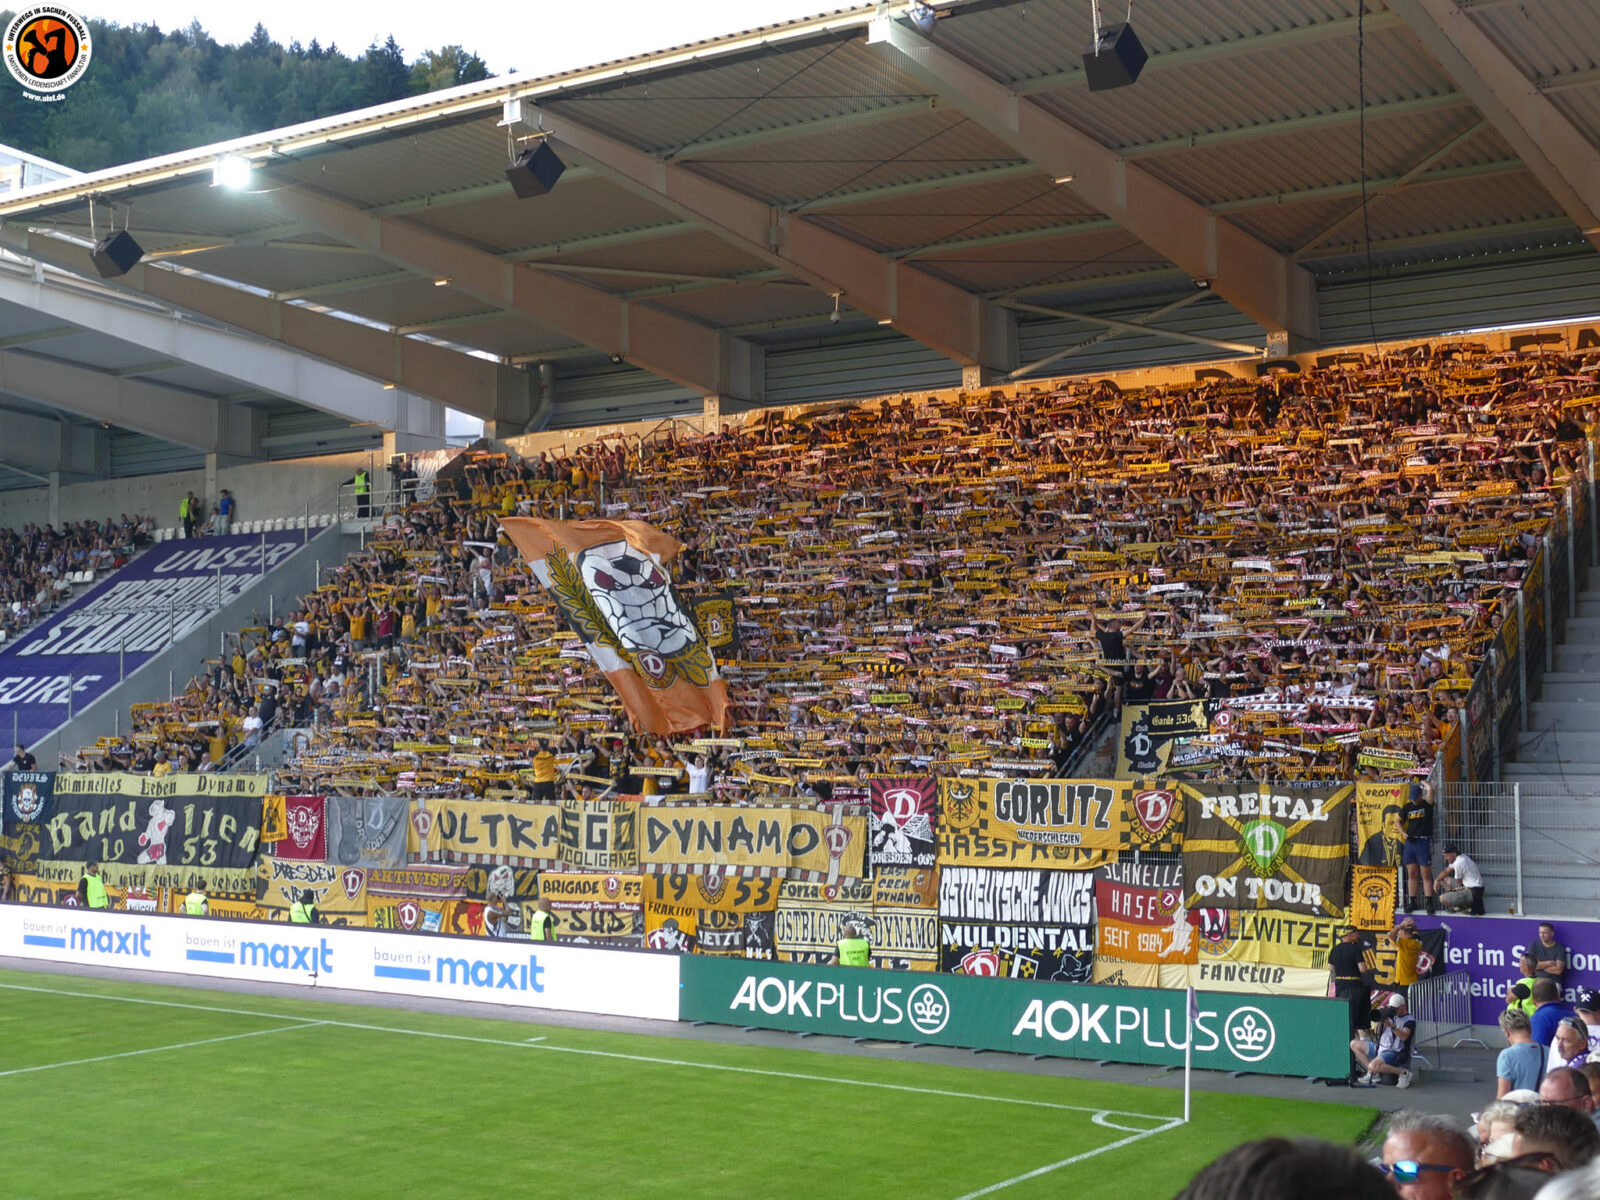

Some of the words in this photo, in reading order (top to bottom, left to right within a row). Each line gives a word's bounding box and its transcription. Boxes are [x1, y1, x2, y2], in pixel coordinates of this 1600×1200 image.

[153, 542, 297, 573] UNSER
[196, 774, 255, 799] Dynamo
[1365, 788, 1391, 798] #ROY
[994, 777, 1115, 830] GÖRLITZ
[1201, 792, 1329, 822] FREITAL
[560, 807, 637, 852] SGD
[646, 815, 820, 857] DYNAMO
[560, 845, 637, 868] HOOLIGANS
[272, 860, 337, 884] DRESDEN
[369, 869, 450, 888] AKTIVIST
[878, 878, 911, 890] CREW
[1103, 862, 1183, 888] SCHNELLE
[543, 879, 600, 895] BRIGADE
[733, 876, 773, 907] 53
[876, 890, 922, 905] DYNAMO
[939, 867, 1041, 923] OSTDEUTSCHE
[1042, 871, 1094, 925] JUNGS
[1195, 874, 1238, 899] ON
[1244, 877, 1322, 906] TOUR
[1111, 889, 1158, 920] HASE
[23, 918, 54, 932] bauen
[55, 923, 68, 934] ist
[698, 908, 740, 929] LOS
[776, 910, 847, 943] OSTBLOCK
[874, 914, 938, 949] DYNAMO
[70, 924, 152, 958] maxit
[186, 931, 220, 947] bauen
[223, 936, 236, 949] ist
[942, 923, 1093, 951] MULDENTAL
[1103, 926, 1130, 949] SEIT
[1137, 932, 1164, 953] 1984
[240, 938, 334, 974] maxit
[373, 947, 413, 963] bauen
[416, 953, 431, 965] ist
[1443, 941, 1472, 965] ier
[1477, 942, 1505, 967] im
[436, 954, 545, 993] maxit
[1200, 963, 1286, 985] FANCLUB
